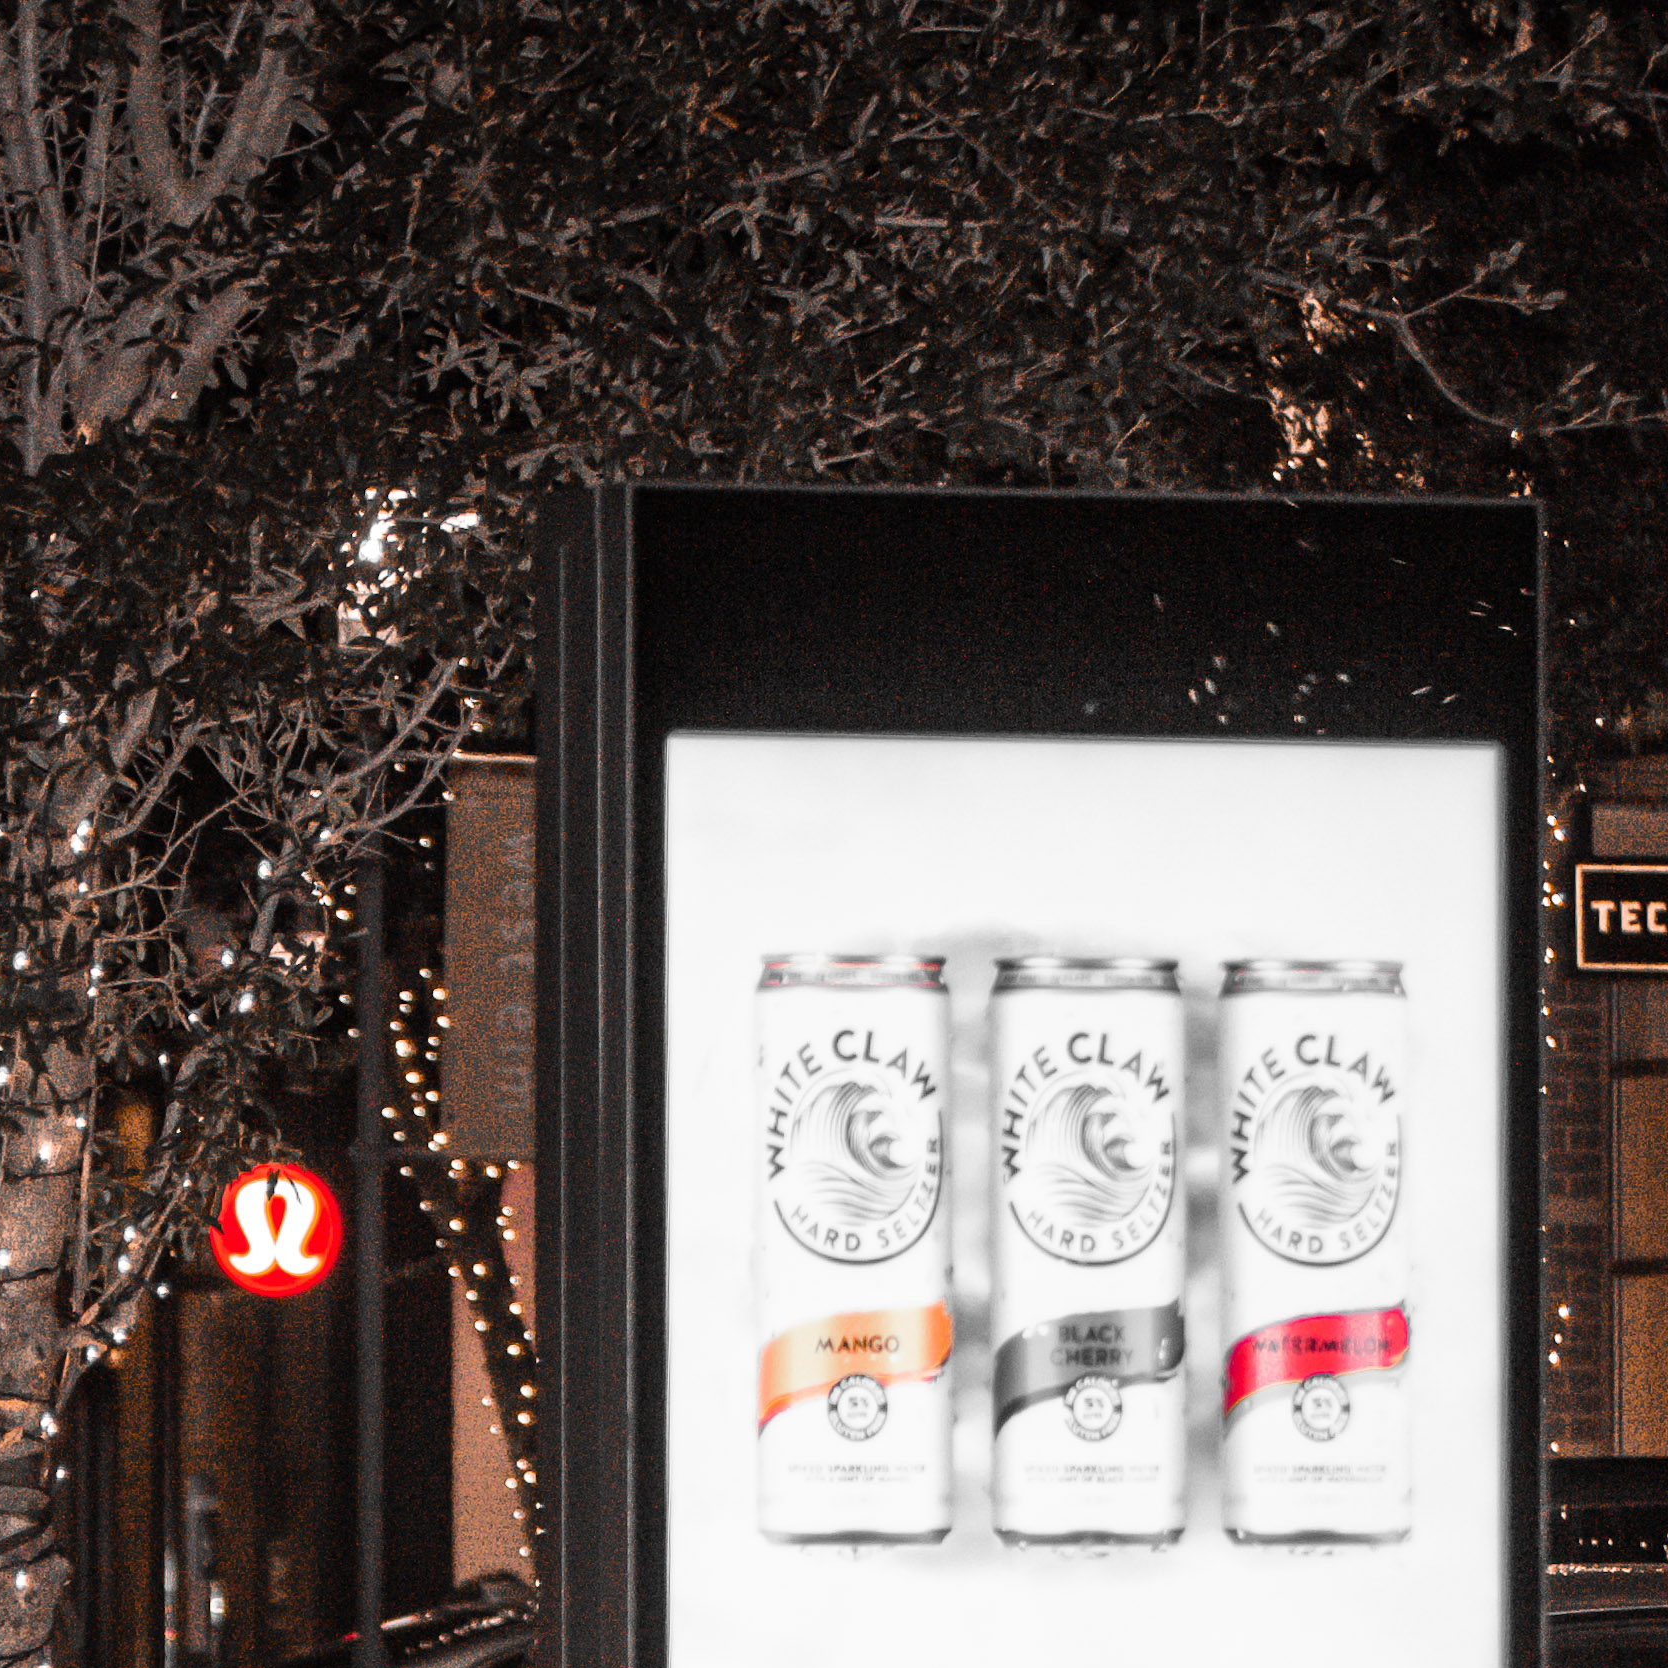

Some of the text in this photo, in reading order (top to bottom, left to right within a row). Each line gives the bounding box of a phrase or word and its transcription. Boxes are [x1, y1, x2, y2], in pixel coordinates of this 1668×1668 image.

[766, 1028, 937, 1181] WHITE CLAW
[1001, 1031, 1170, 1184] WHITE CLAW
[1230, 1033, 1396, 1184] WHITE CLAW
[791, 1136, 939, 1251] HARD SELTZER
[1026, 1141, 1170, 1253] HARD SELTZER
[1254, 1142, 1397, 1254] HARD SELTZER
[815, 1334, 900, 1353] MANGO
[1050, 1347, 1133, 1366] CHERRY
[1058, 1324, 1125, 1343] BLACK
[1253, 1337, 1390, 1354] WATERMELON
